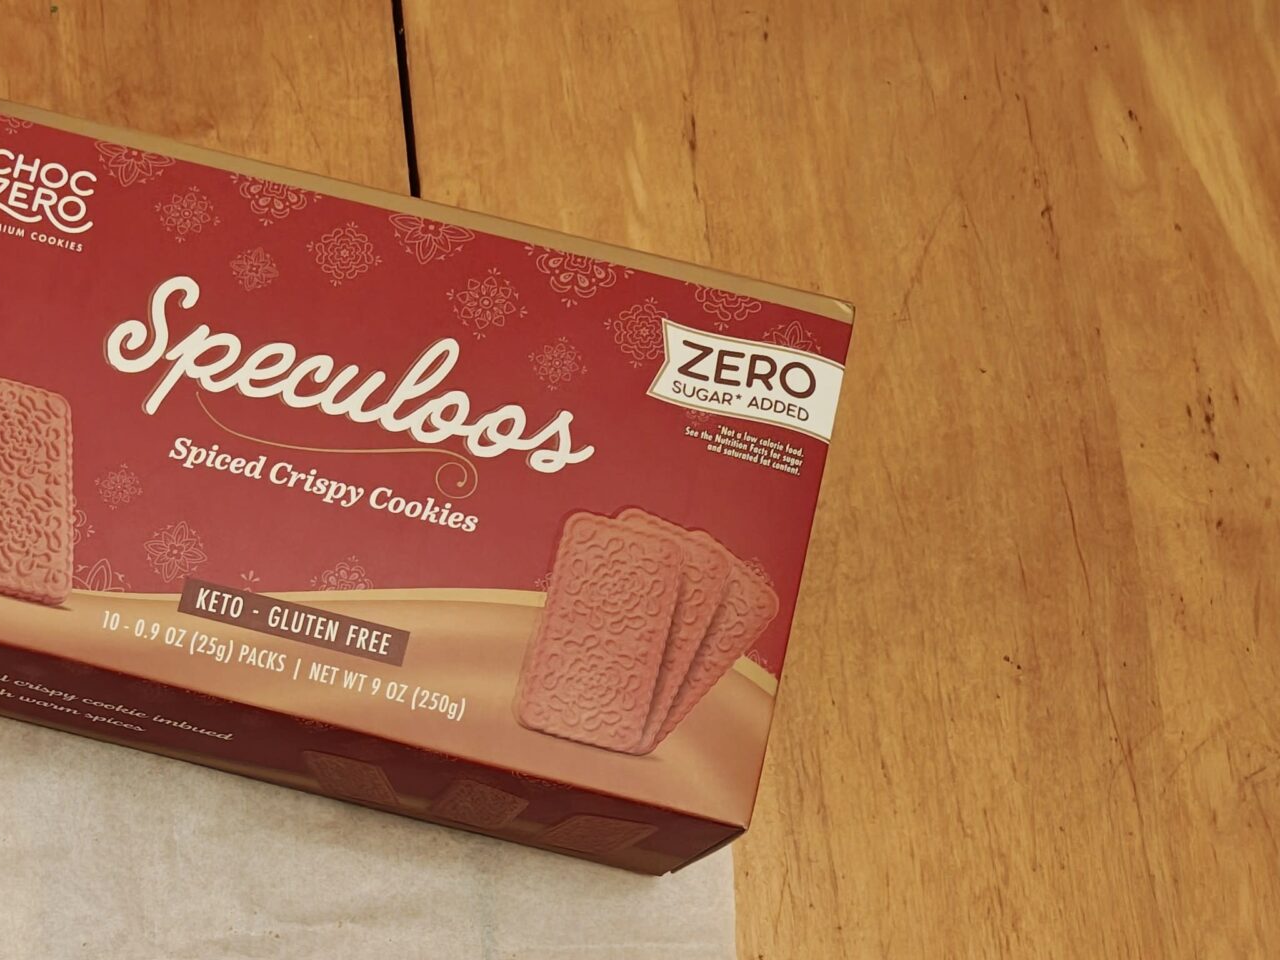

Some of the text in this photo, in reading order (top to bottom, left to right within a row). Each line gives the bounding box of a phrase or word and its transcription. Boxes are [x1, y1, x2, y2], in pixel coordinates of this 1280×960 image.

[30, 231, 83, 252] COOKIES
[105, 275, 595, 474] Speculoos
[677, 339, 816, 399] ZERO
[747, 396, 810, 422] ADDED
[685, 426, 803, 467] See the Nutrition Facts for sugar
[707, 443, 800, 476] and saturated fat content.
[736, 431, 742, 439] a
[744, 431, 758, 444] low
[759, 438, 784, 451] calorie
[785, 443, 805, 458] food.
[168, 436, 479, 533] Spiced Crispy Cookies
[195, 587, 245, 620] KETO
[267, 605, 340, 643] GLUTEN
[345, 624, 393, 656] FREE
[102, 610, 120, 632] 10
[134, 619, 160, 641] 0.9
[164, 626, 186, 648] OZ
[189, 631, 234, 664] (25g)
[238, 645, 287, 673] PACKS
[308, 662, 340, 685] NET
[342, 669, 368, 693] WT
[371, 677, 382, 696] 9
[385, 681, 409, 703] OZ
[411, 686, 467, 722] (250g)
[13, 678, 79, 702] crispy
[82, 697, 149, 720] cookie
[152, 713, 235, 741] imbued
[19, 695, 83, 715] warm
[83, 712, 148, 734] spices
